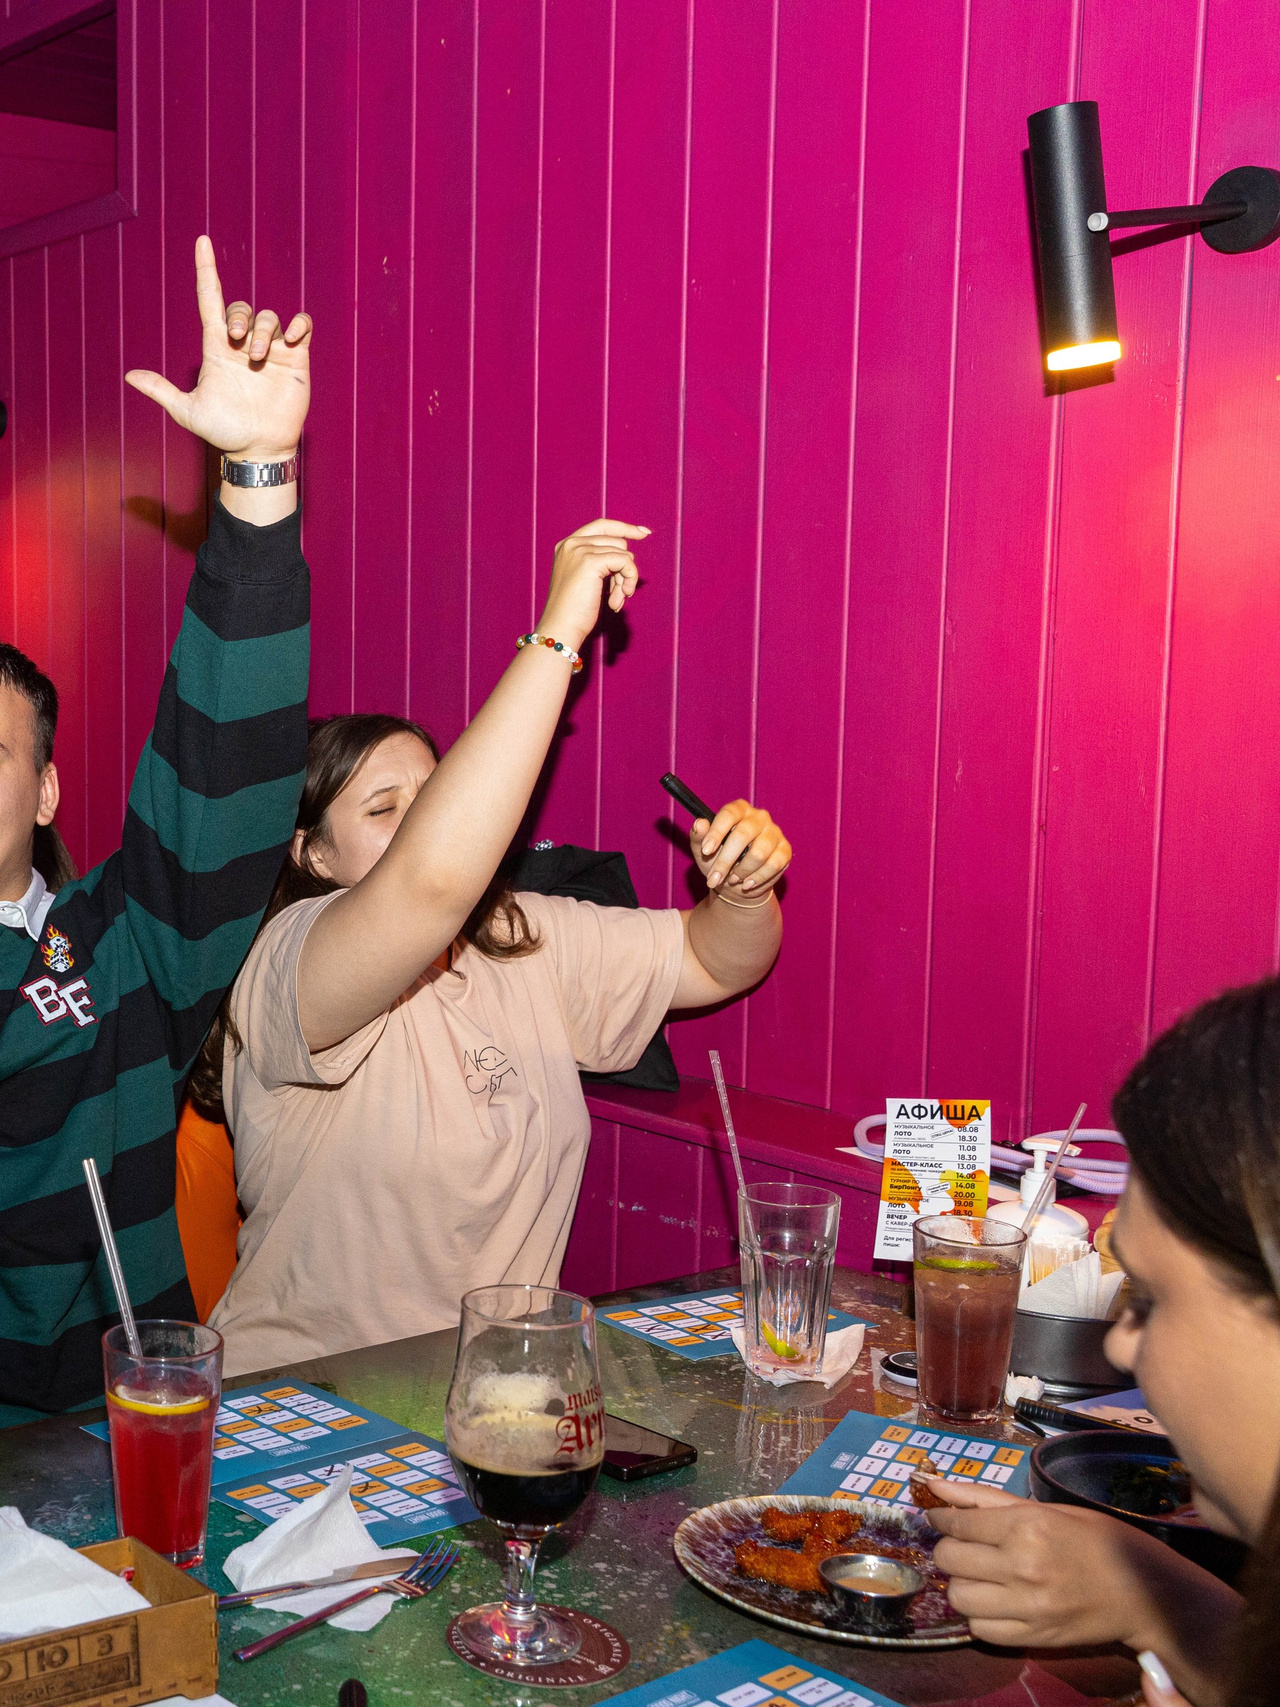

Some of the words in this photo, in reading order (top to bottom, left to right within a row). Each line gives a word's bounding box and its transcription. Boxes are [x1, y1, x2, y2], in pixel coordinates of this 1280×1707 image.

[19, 974, 100, 1029] BF
[895, 1103, 983, 1121] АФИША
[958, 1144, 977, 1152] 11.08
[891, 1161, 943, 1169] МАСТЕР-КЛАСС
[495, 1668, 587, 1683] ORIGINALE
